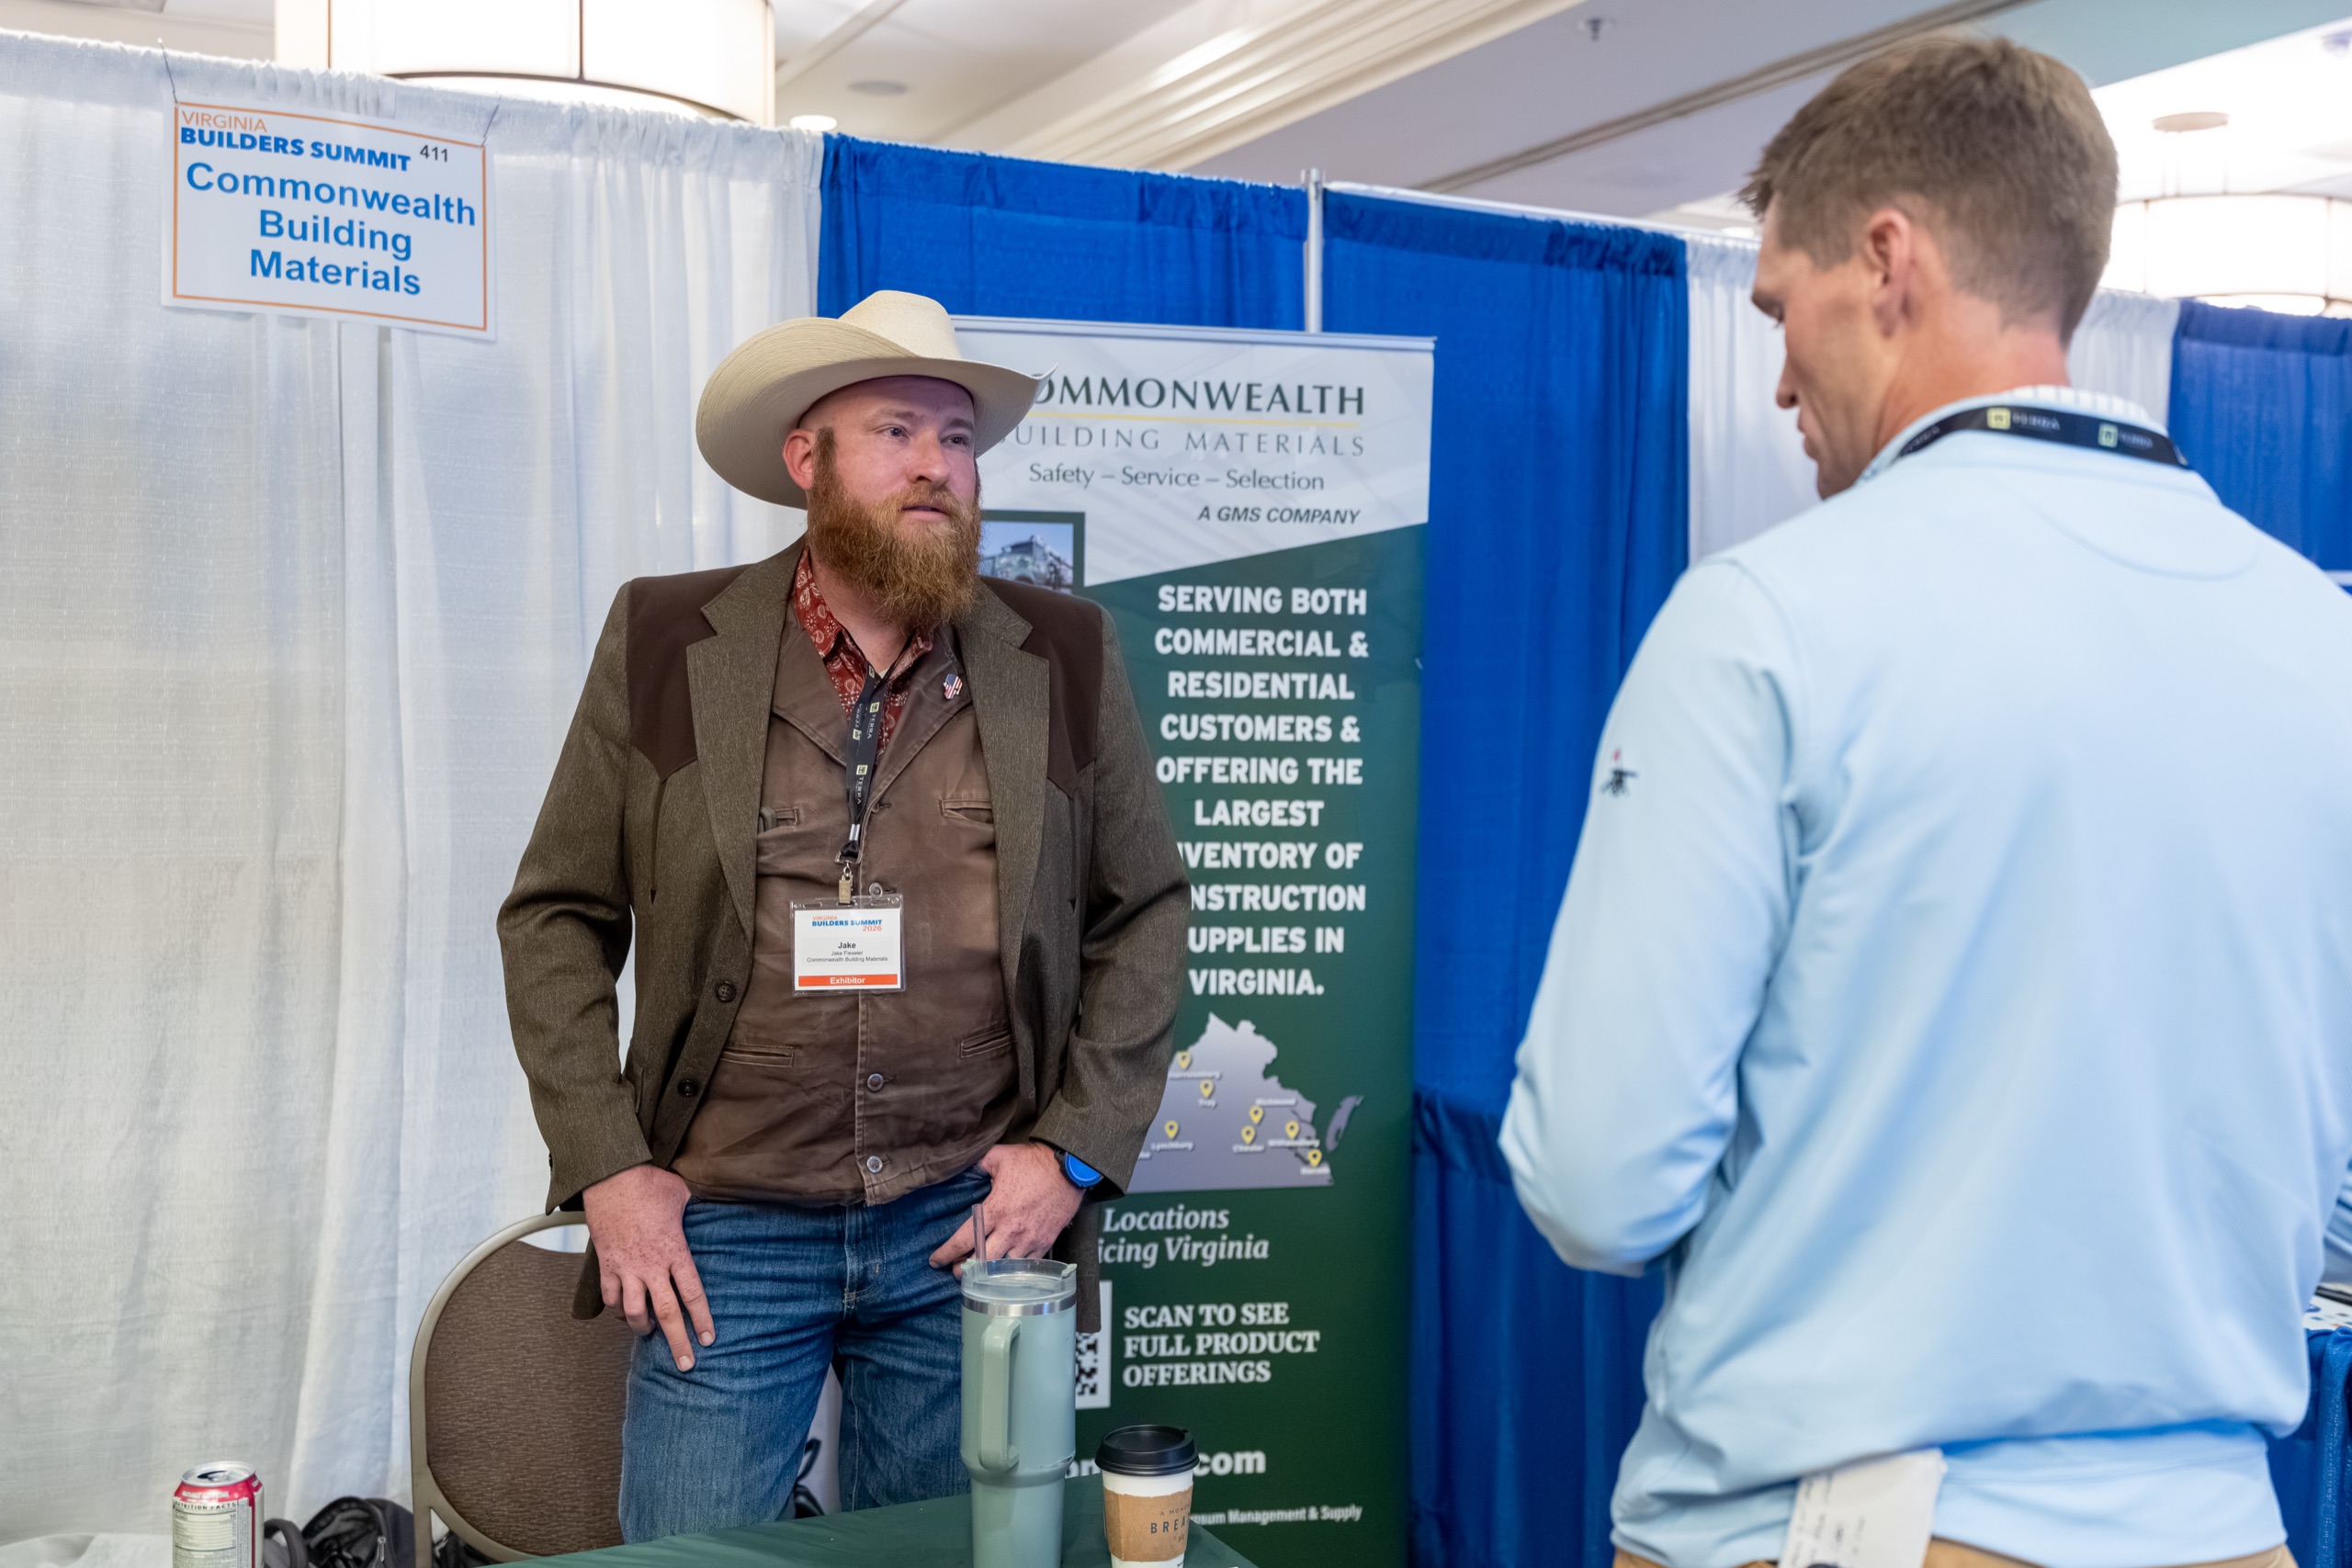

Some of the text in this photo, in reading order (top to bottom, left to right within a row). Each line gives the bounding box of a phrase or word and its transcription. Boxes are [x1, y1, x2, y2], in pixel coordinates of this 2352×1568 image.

[182, 110, 267, 132] VIRGINIA
[181, 127, 411, 172] BUILDERS SUMMIT
[420, 144, 448, 163] 411
[187, 162, 475, 226] Commonwealth
[260, 209, 412, 262] Building
[251, 249, 421, 295] Materials
[1030, 373, 1364, 415] OMMONWEALTH
[1000, 424, 1364, 457] UILDING MATERIALS
[1029, 463, 1095, 489] Safety
[1121, 465, 1200, 487] Service
[1226, 468, 1325, 491] Selection
[1198, 508, 1361, 525] A GMS COMPANY
[1158, 584, 1367, 615] SERVING BOTH
[1154, 627, 1369, 658] COMMERCIAL &
[1168, 671, 1355, 700] RESIDENTIAL
[1160, 713, 1361, 743] CUSTOMERS &
[1156, 756, 1363, 784] OFFERING THE
[1194, 799, 1325, 827] LARGEST
[1177, 841, 1363, 869] VENTORY OF
[1191, 884, 1366, 911] NSTRUCTION
[1187, 926, 1344, 953] UPPLIES IN
[830, 976, 865, 985] Exhibitor
[1188, 968, 1325, 996] VIRGINIA.
[1102, 1203, 1230, 1233] Locations
[1098, 1233, 1270, 1269] icing Virginia
[1124, 1303, 1290, 1329] SCAN TO SEE
[1124, 1330, 1320, 1359] FULL PRODUCT
[1122, 1360, 1272, 1387] OFFERINGS
[1227, 1507, 1306, 1526] Management
[1320, 1503, 1363, 1522] Supply
